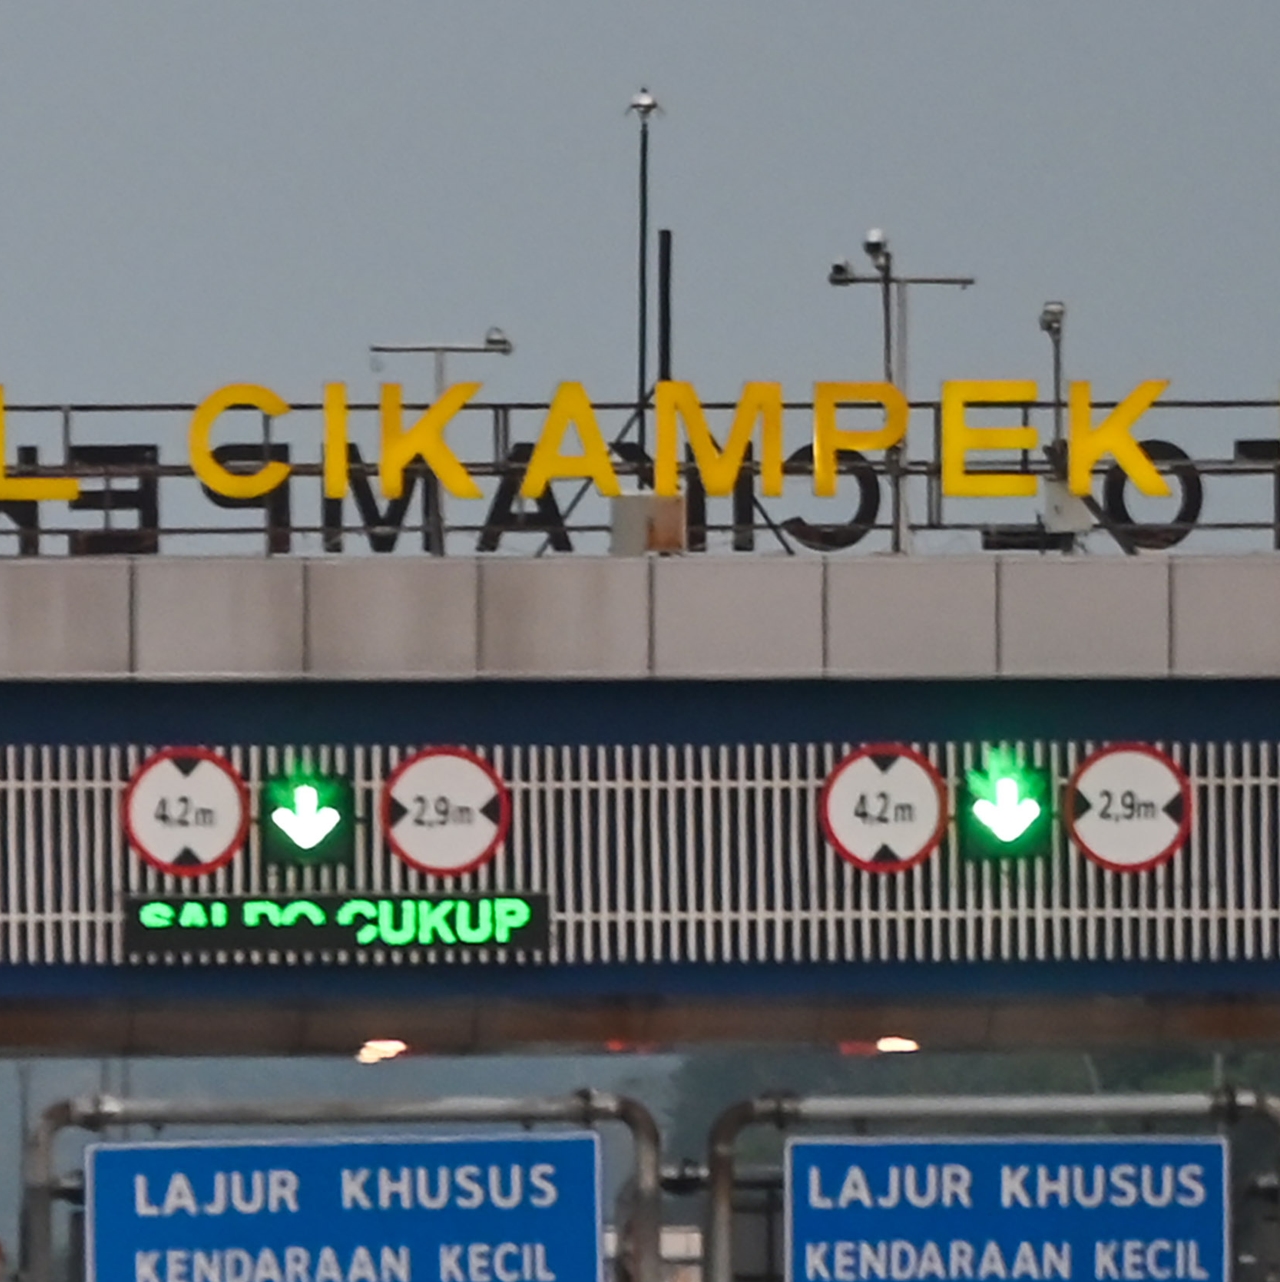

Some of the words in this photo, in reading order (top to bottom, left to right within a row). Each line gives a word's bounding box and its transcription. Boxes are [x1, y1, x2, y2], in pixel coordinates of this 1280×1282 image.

[187, 379, 1172, 499] CIKAMPEK
[336, 898, 532, 946] CUKUP
[134, 1169, 300, 1216] LAJUR
[340, 1163, 558, 1210] KHUSUS
[807, 1164, 972, 1209] LAJUR
[1000, 1163, 1206, 1208] KHUSUS
[804, 1240, 1072, 1282] KENDARAAN
[1094, 1240, 1209, 1281] KECIL
